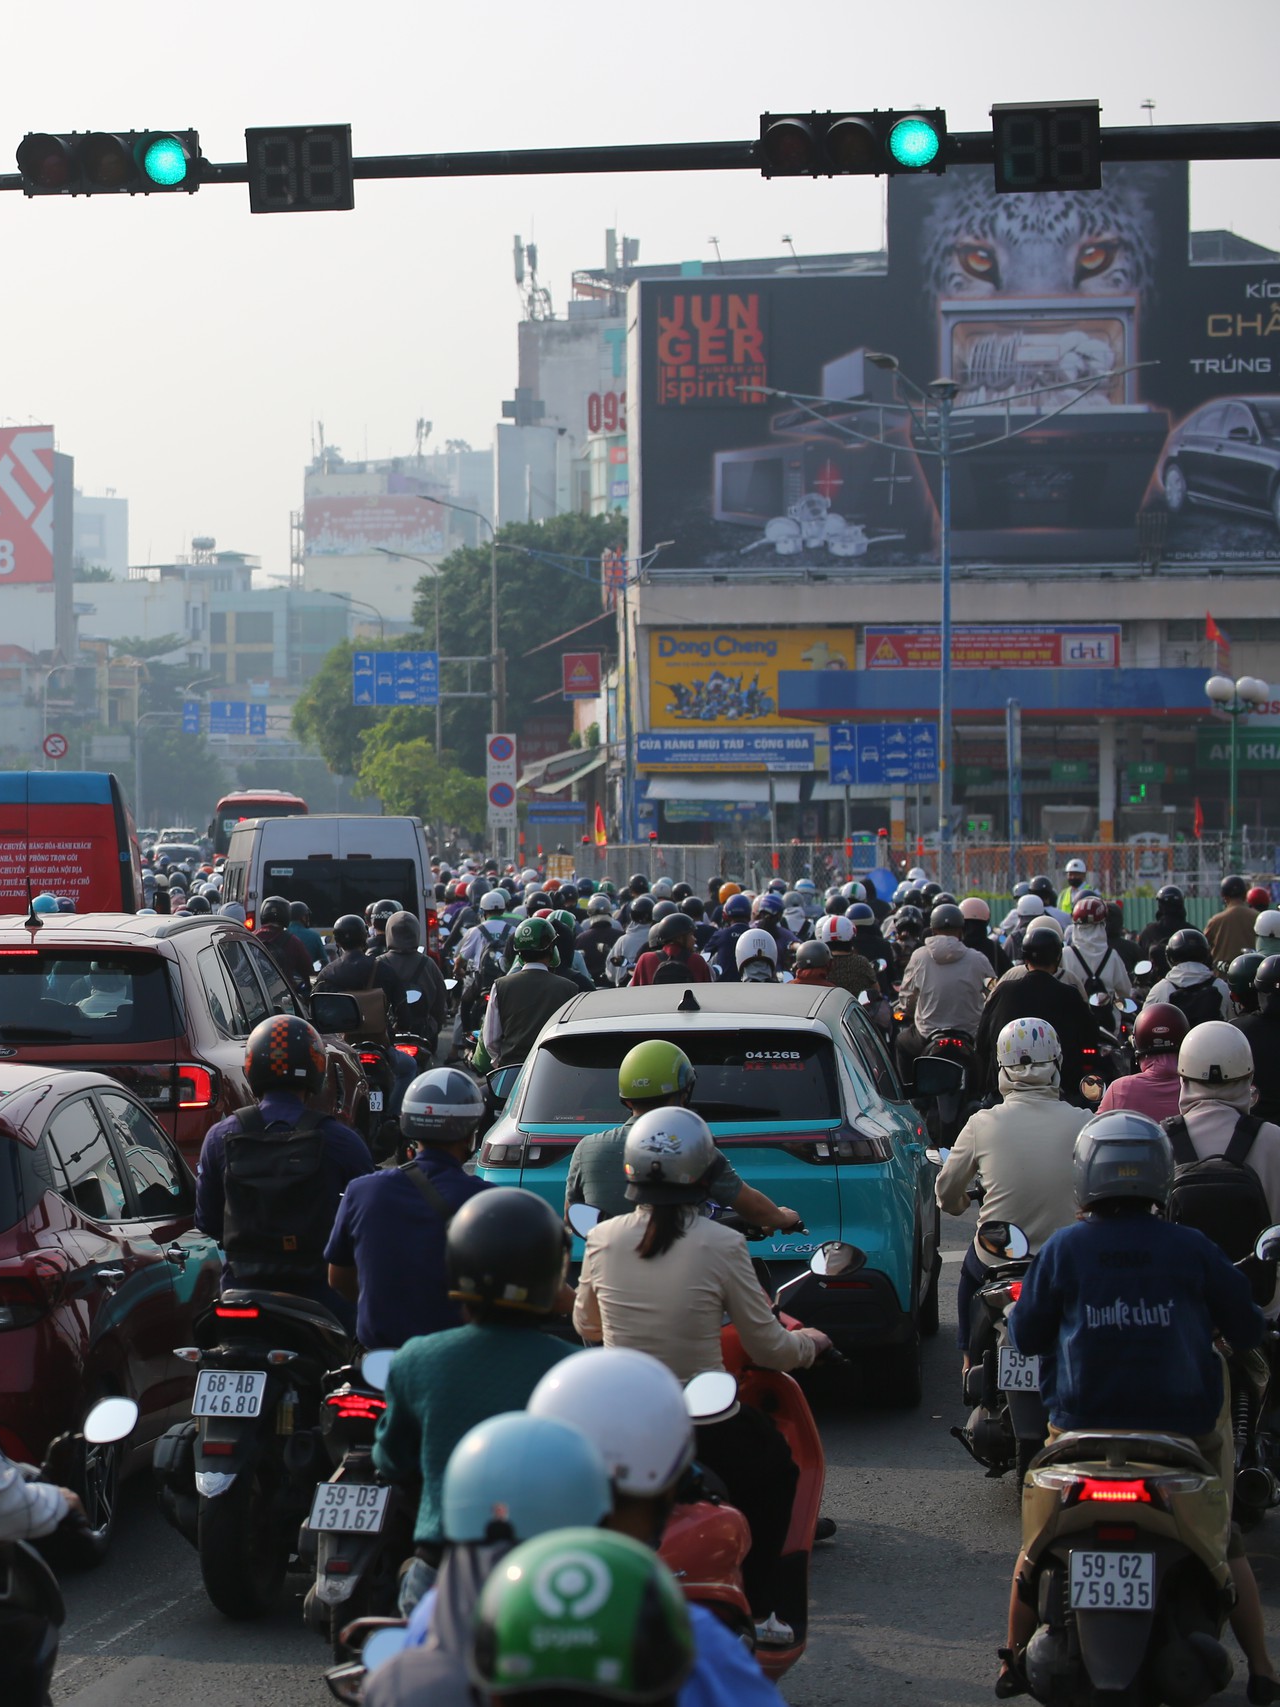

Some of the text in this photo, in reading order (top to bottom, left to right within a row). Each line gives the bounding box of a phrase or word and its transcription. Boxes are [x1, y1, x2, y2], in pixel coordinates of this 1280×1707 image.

[658, 294, 758, 330] JUN
[658, 328, 766, 364] GER
[1189, 353, 1272, 373] TRÚNG
[667, 374, 736, 405] spirit
[658, 635, 778, 658] Dong Cheng
[639, 737, 662, 750] CỬA
[663, 737, 695, 750] HÀNG
[754, 737, 785, 751] CỘNG
[745, 1051, 800, 1059] 04126B
[631, 1078, 650, 1088] ACE
[771, 1243, 795, 1253] VF
[207, 1374, 255, 1393] 68-AB
[200, 1394, 258, 1414] 146.80
[325, 1486, 379, 1507] 59-D3
[318, 1507, 380, 1530] 131.67
[1082, 1554, 1142, 1579] 59-G2
[1074, 1581, 1150, 1607] 759.35
